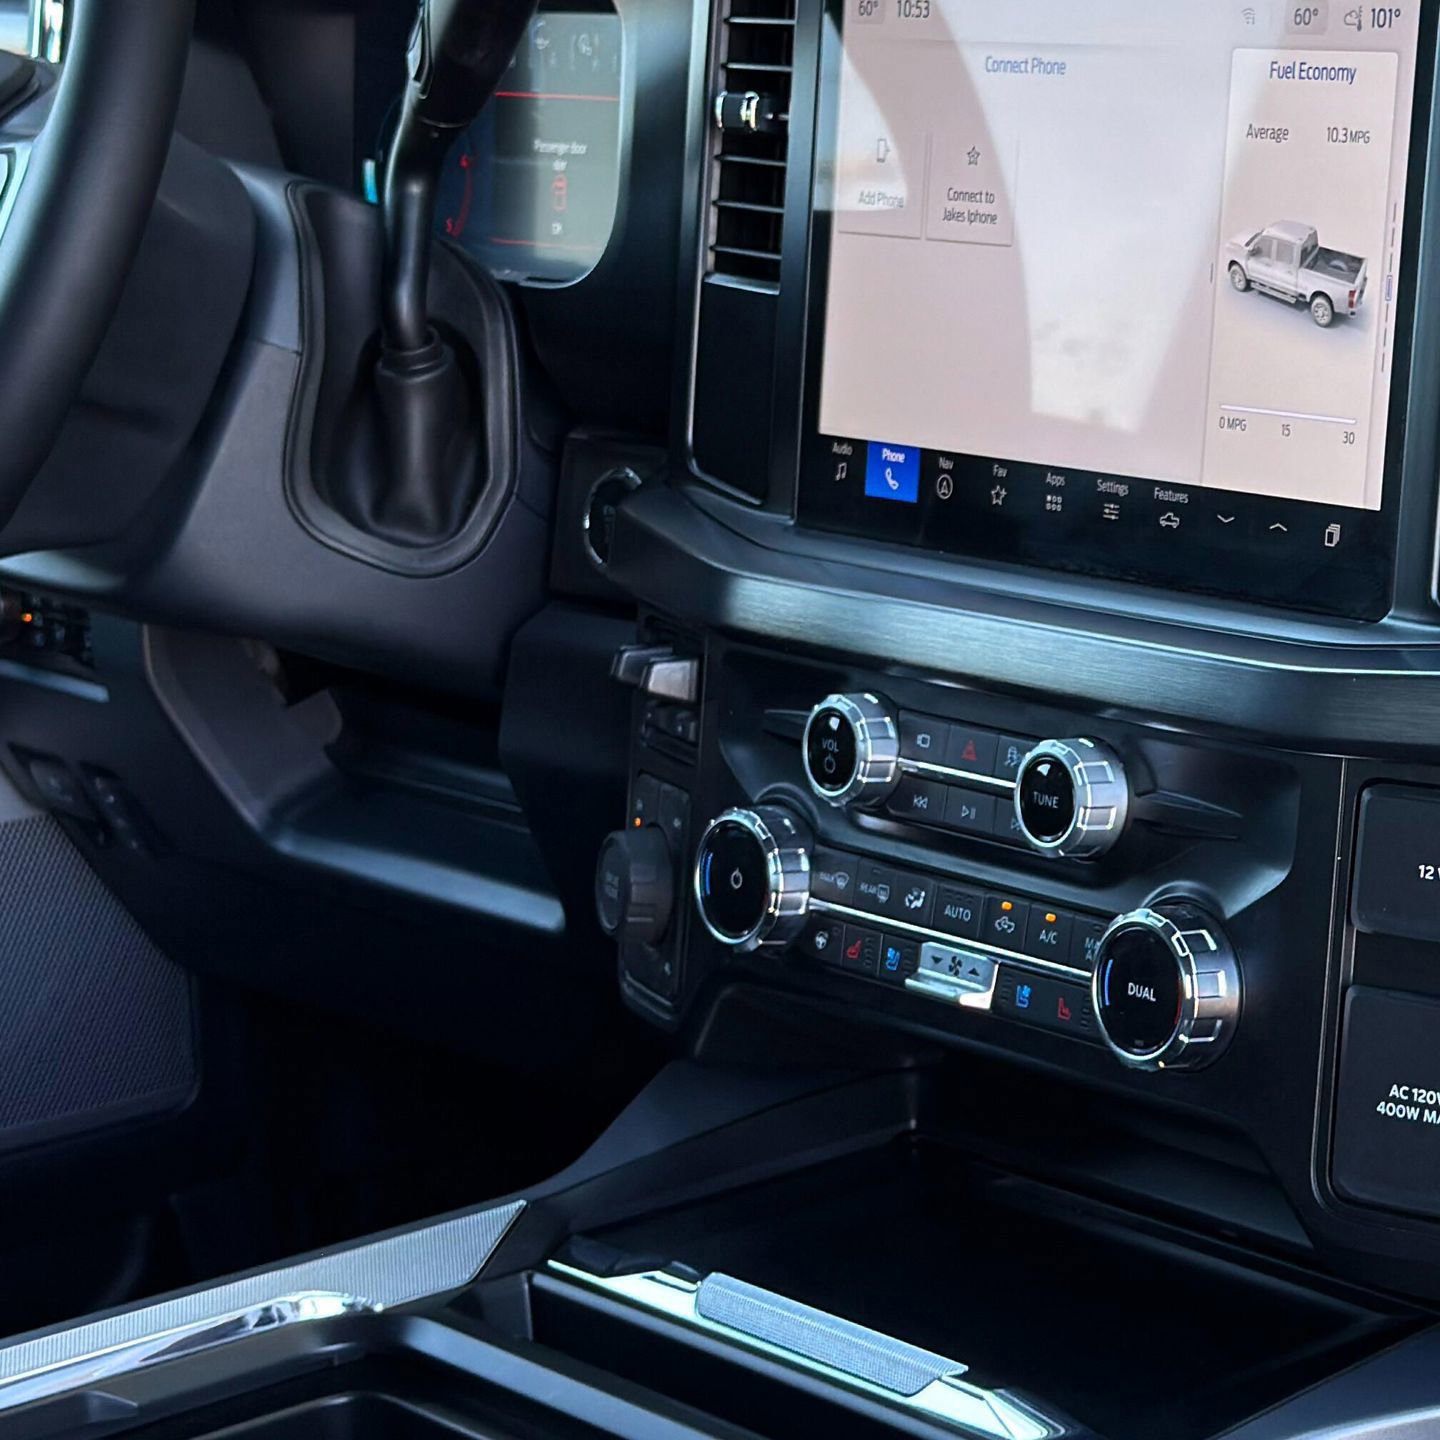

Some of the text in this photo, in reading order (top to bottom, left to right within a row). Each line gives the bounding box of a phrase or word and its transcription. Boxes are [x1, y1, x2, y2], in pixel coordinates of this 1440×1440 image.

[896, 0, 931, 18] 10:53
[1294, 7, 1401, 28] 60° 101°
[985, 56, 1067, 75] Connect Phone
[1269, 61, 1358, 85] Fuel Economy
[1246, 123, 1290, 143] Average
[858, 190, 905, 209] Add Phone
[947, 187, 996, 204] Connect to
[942, 207, 966, 223] Jakes
[1218, 416, 1247, 432] 0 MPG
[1281, 424, 1291, 438] 15
[1343, 431, 1356, 445] 30
[832, 441, 853, 456] Audio
[882, 447, 906, 464] Phone
[938, 456, 954, 471] Nav
[992, 463, 1008, 478] Fav
[1046, 471, 1066, 488] Apps
[1096, 478, 1130, 497] Settings
[1154, 486, 1189, 505] Features
[821, 738, 840, 753] VOL
[1032, 792, 1060, 809] TUNE
[1418, 864, 1434, 880] 12
[944, 904, 971, 923] AUTO
[1039, 930, 1057, 945] A/C
[1127, 982, 1157, 1002] DUAL
[1389, 1083, 1409, 1102] AC
[1376, 1101, 1420, 1121] 400W
